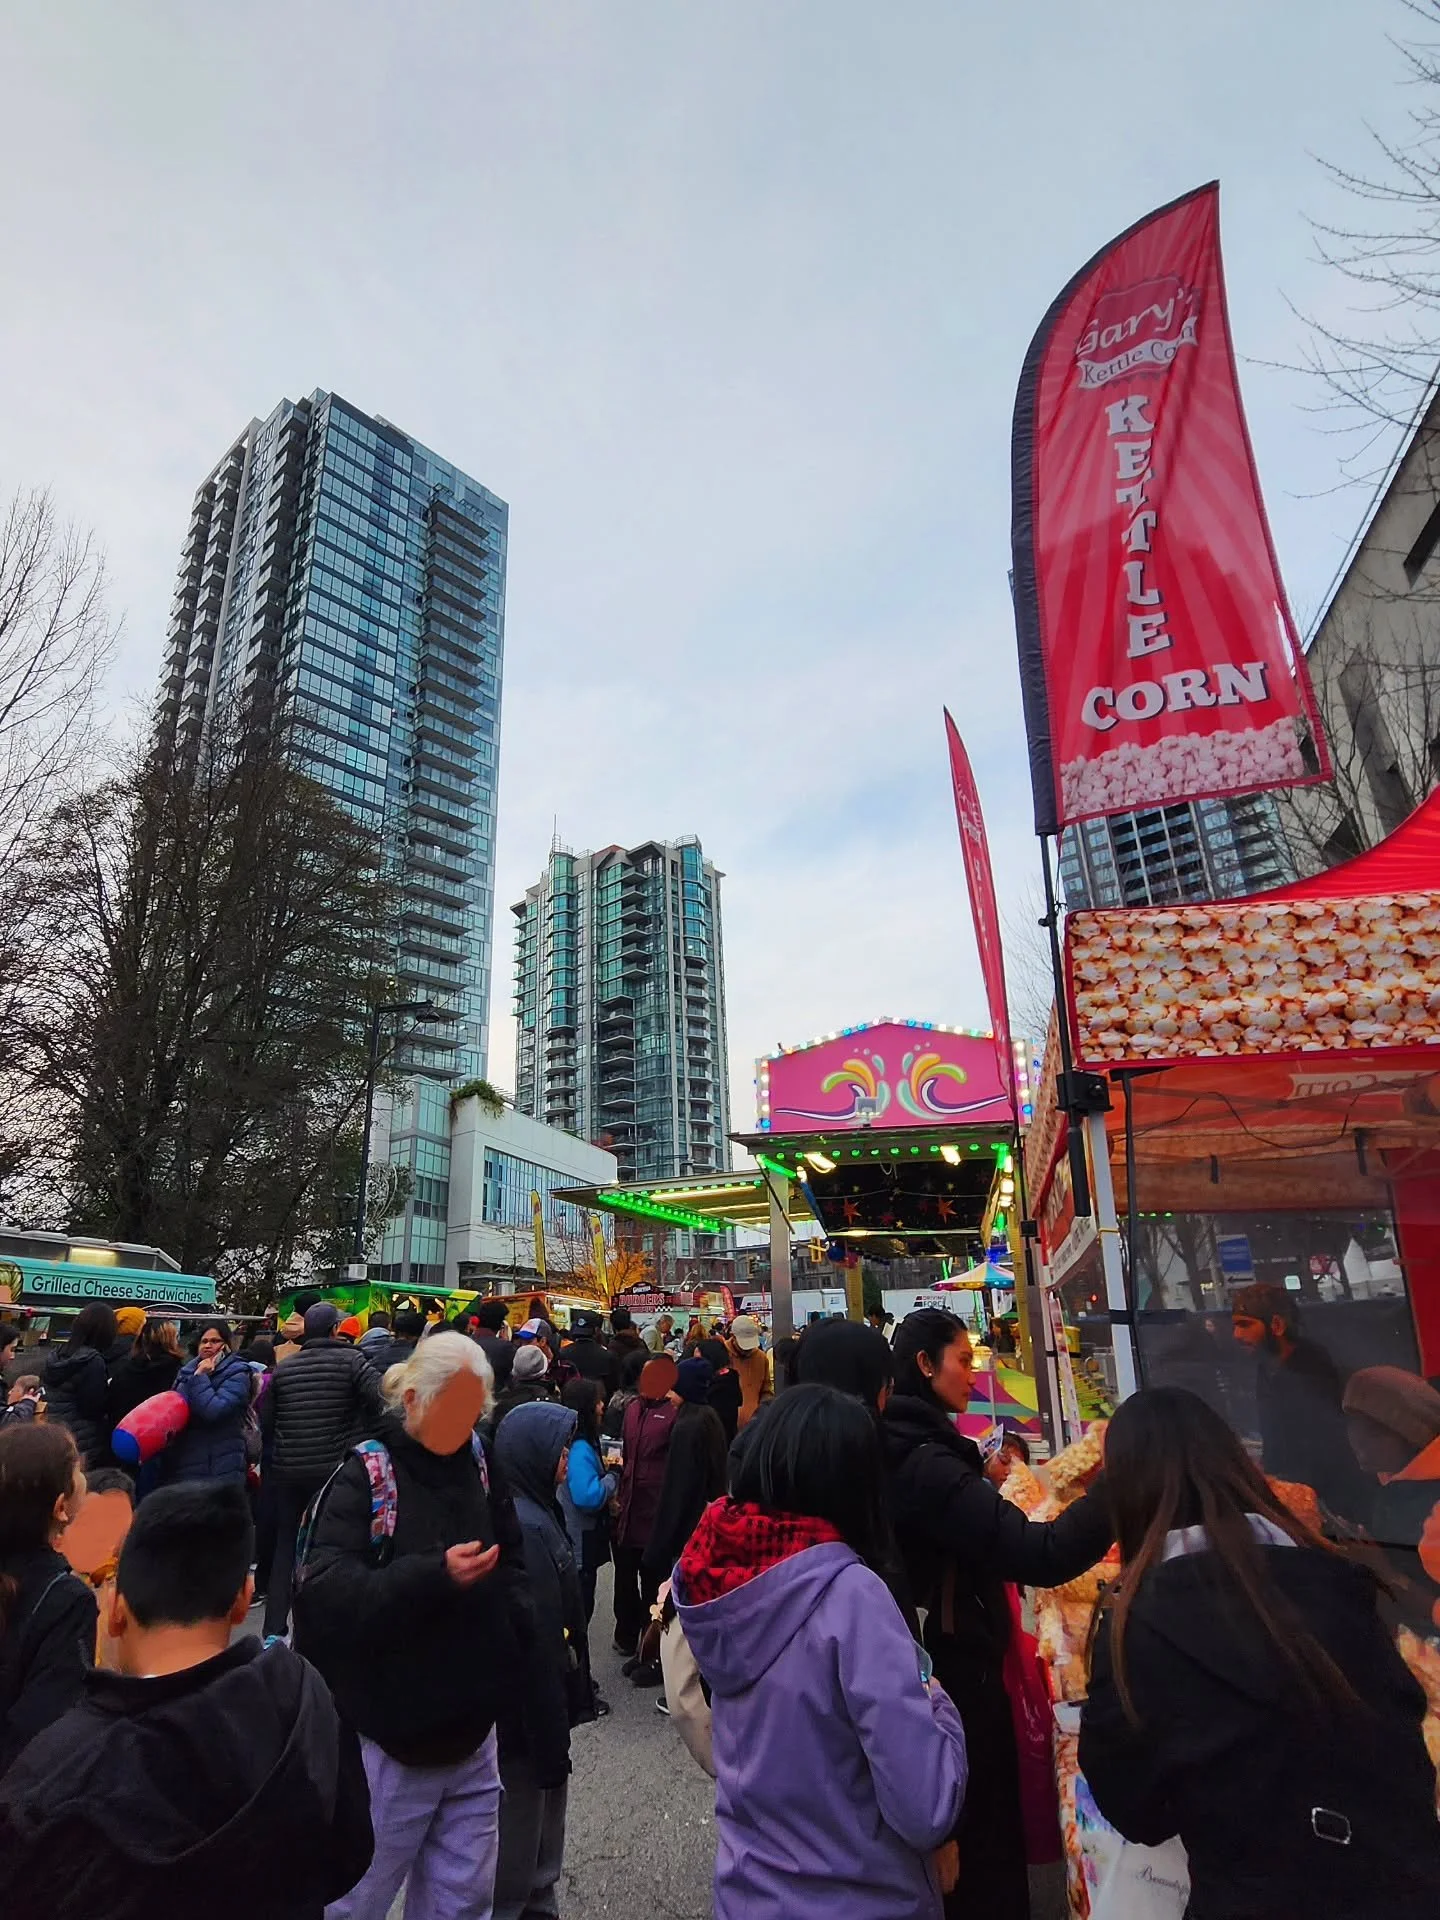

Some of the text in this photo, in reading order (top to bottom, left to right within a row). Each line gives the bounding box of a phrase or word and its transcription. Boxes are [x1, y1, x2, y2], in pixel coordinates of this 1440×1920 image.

[1083, 325, 1193, 384] Kettle Con
[1105, 394, 1171, 658] KETTLE
[1081, 661, 1268, 731] CORN
[31, 1275, 202, 1303] Grilled Cheese Sandwiches
[619, 1293, 665, 1306] BURGERS
